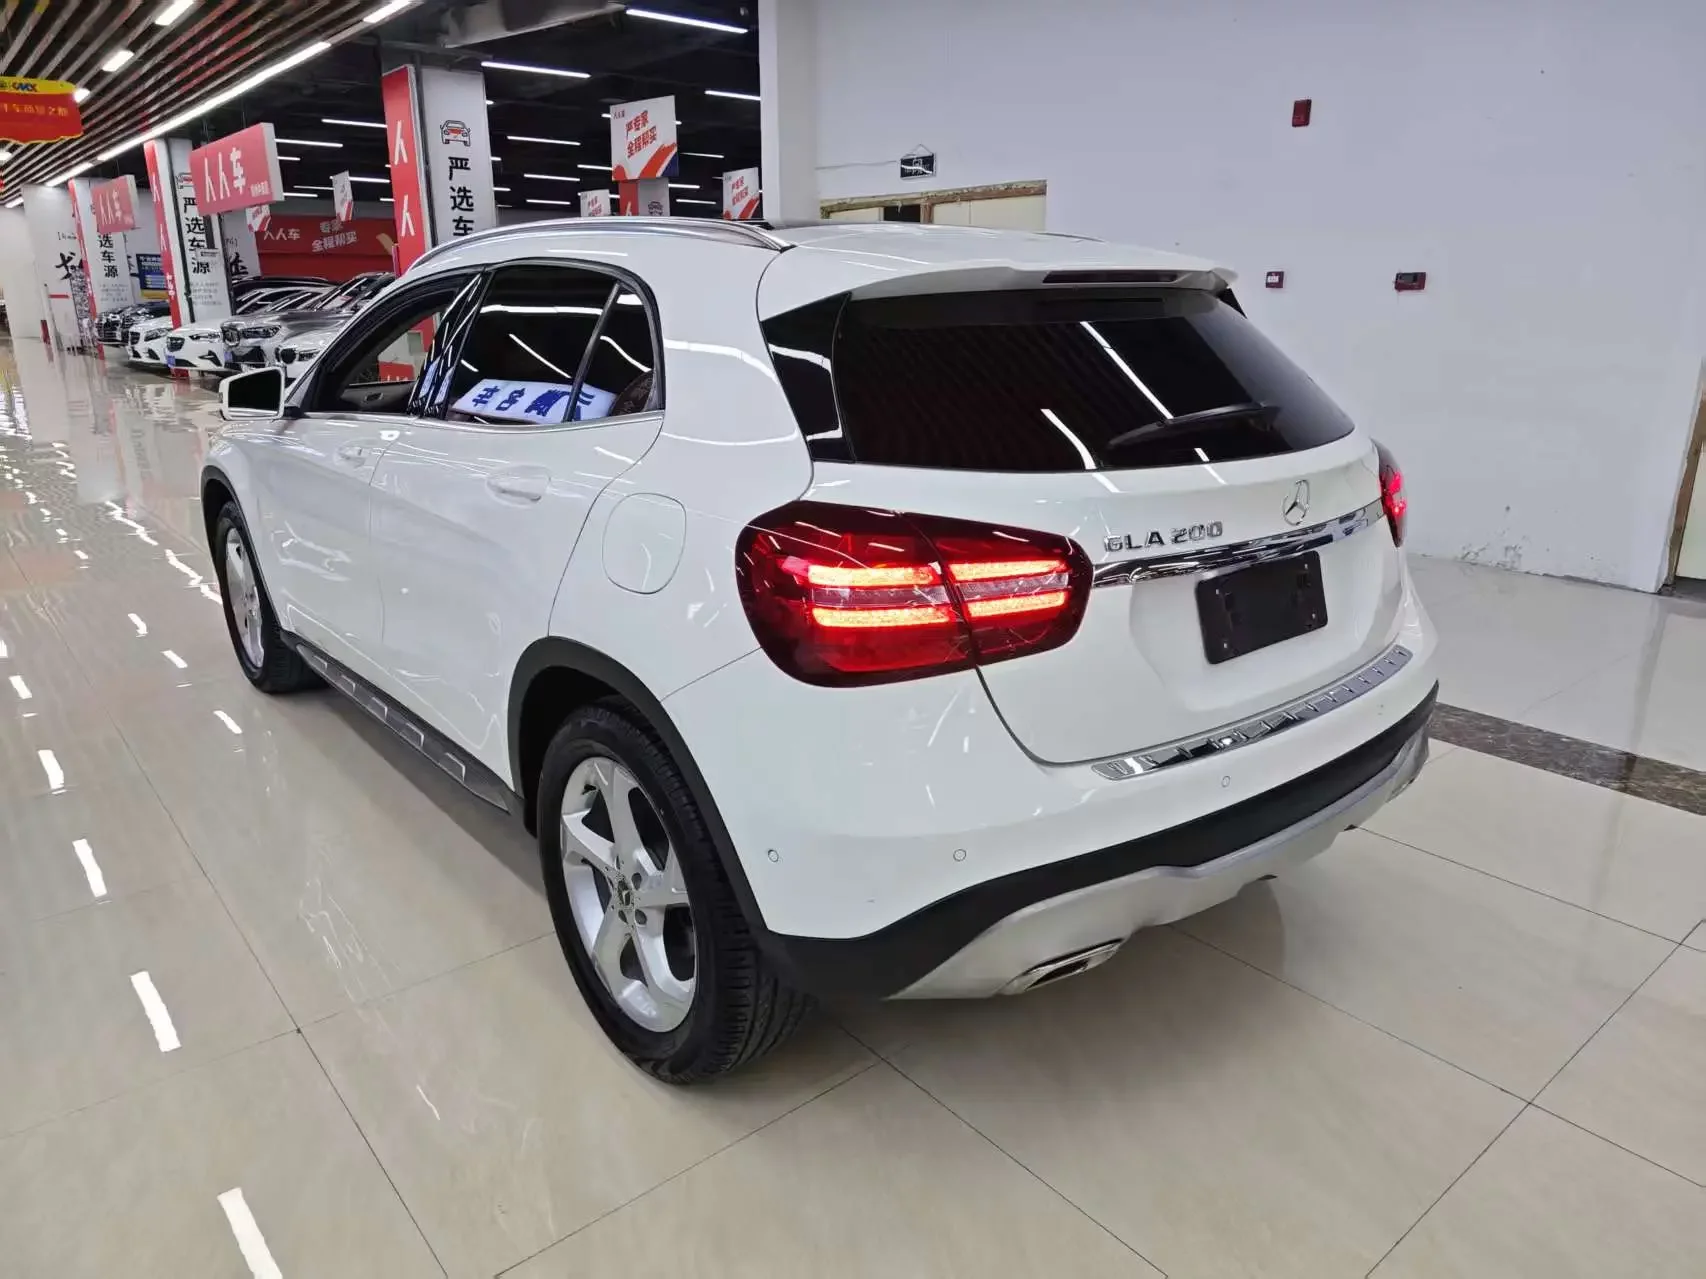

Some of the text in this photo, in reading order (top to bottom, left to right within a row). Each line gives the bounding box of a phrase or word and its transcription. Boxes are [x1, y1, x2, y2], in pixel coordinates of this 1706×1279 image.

[204, 147, 246, 203] 人人车
[98, 189, 122, 226] 人人车
[263, 228, 301, 241] 人人车
[1104, 520, 1223, 552] GLA 200
